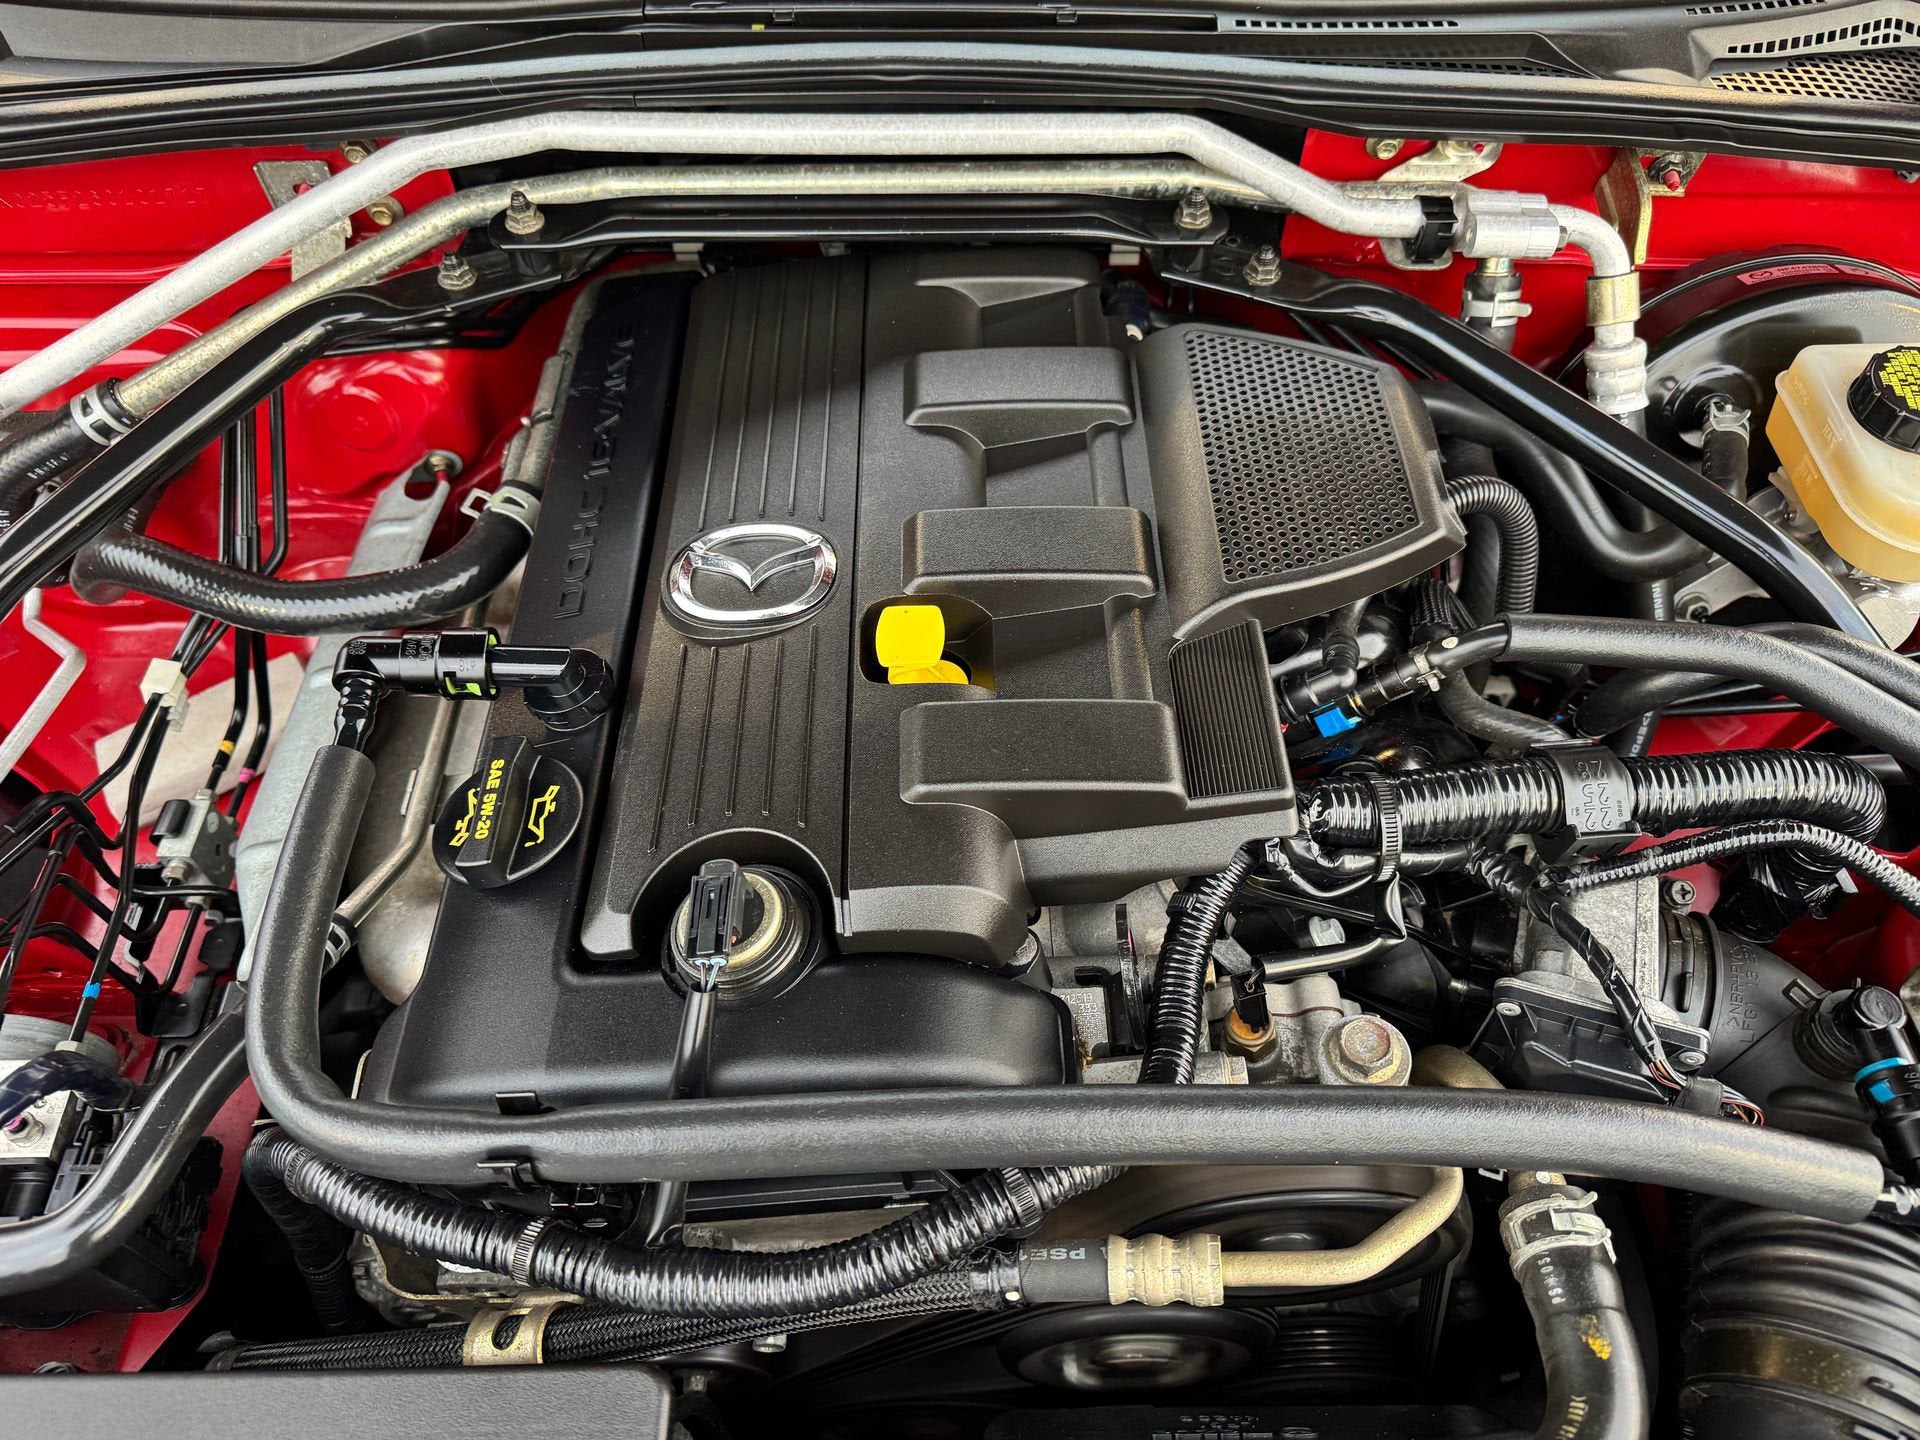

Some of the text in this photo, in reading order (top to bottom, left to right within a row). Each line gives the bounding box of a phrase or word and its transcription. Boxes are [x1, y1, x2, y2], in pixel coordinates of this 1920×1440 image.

[553, 487, 607, 619] DOHC
[1652, 583, 1664, 621] INNE
[474, 759, 505, 840] SAE 5W-20
